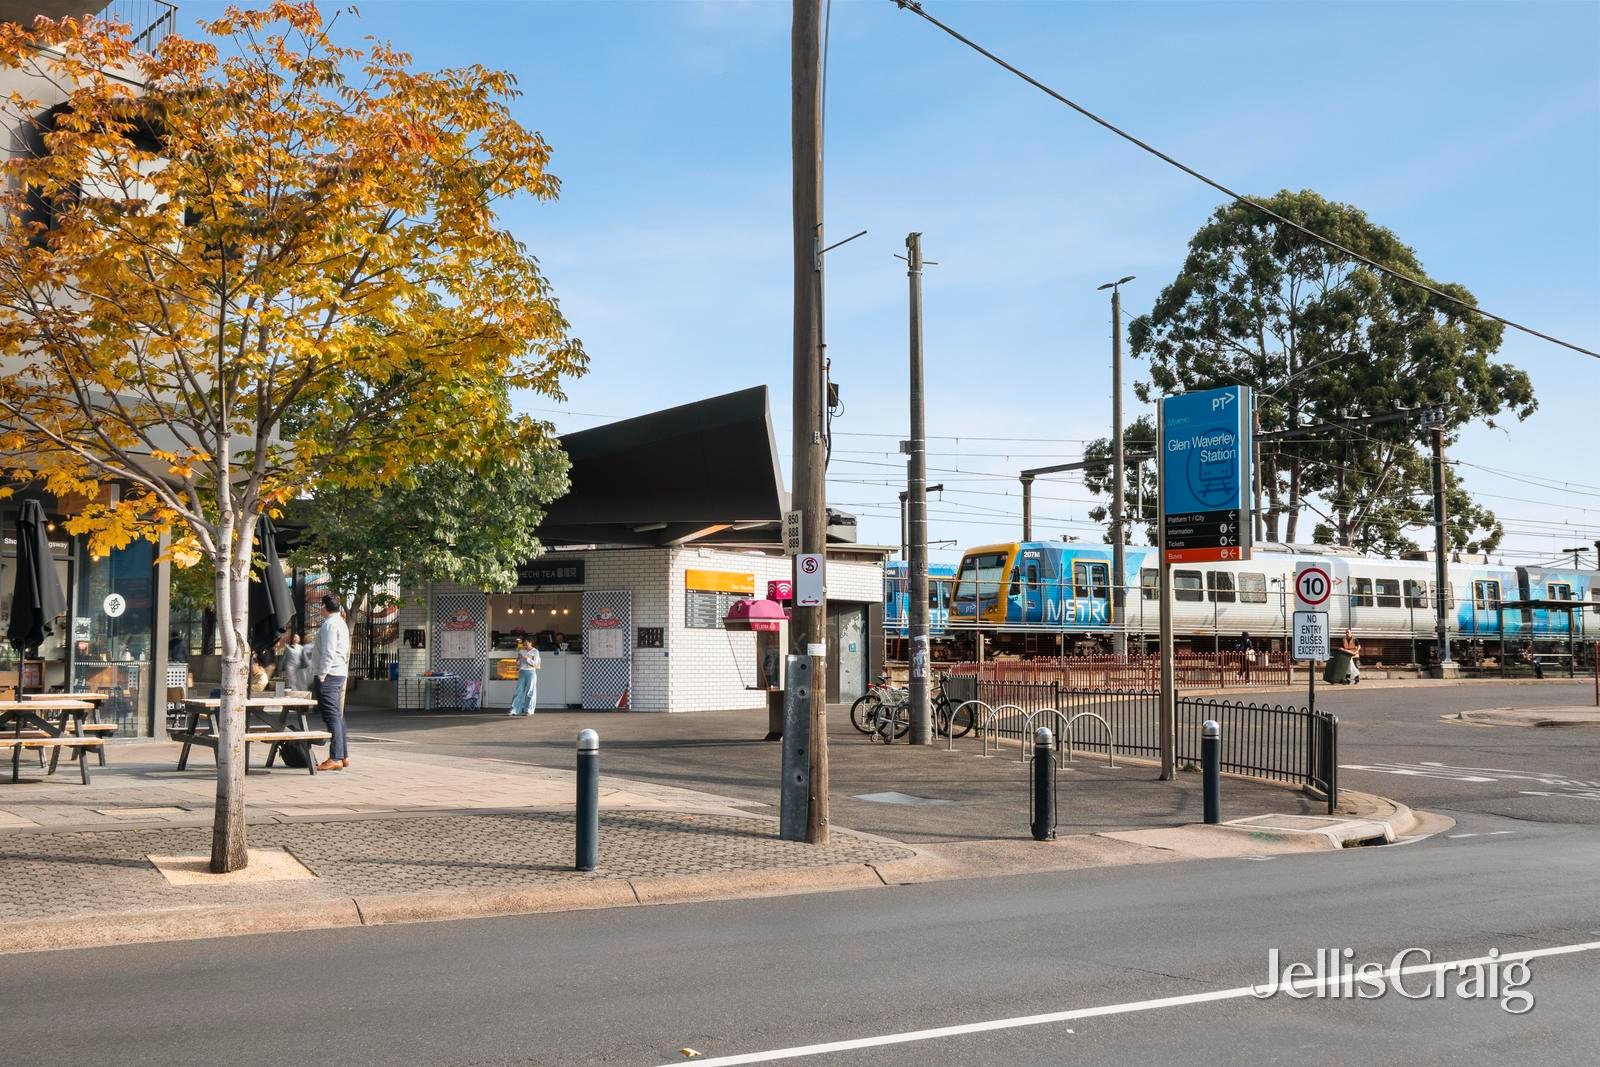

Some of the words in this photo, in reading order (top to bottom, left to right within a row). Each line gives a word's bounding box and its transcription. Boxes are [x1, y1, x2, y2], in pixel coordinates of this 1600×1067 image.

[1168, 439, 1190, 452] Glen
[1191, 432, 1236, 448] Waverley
[1200, 448, 1236, 463] Station
[788, 513, 799, 525] 850
[1167, 515, 1188, 523] Platform
[1194, 514, 1205, 522] City
[788, 526, 799, 538] 888
[788, 537, 799, 549] 889
[542, 570, 556, 578] TEA
[1302, 577, 1324, 596] 10
[1306, 614, 1317, 624] NO
[1301, 625, 1321, 634] ENTRY
[1299, 635, 1323, 645] BUSES
[1297, 645, 1326, 655] EXCEPTED
